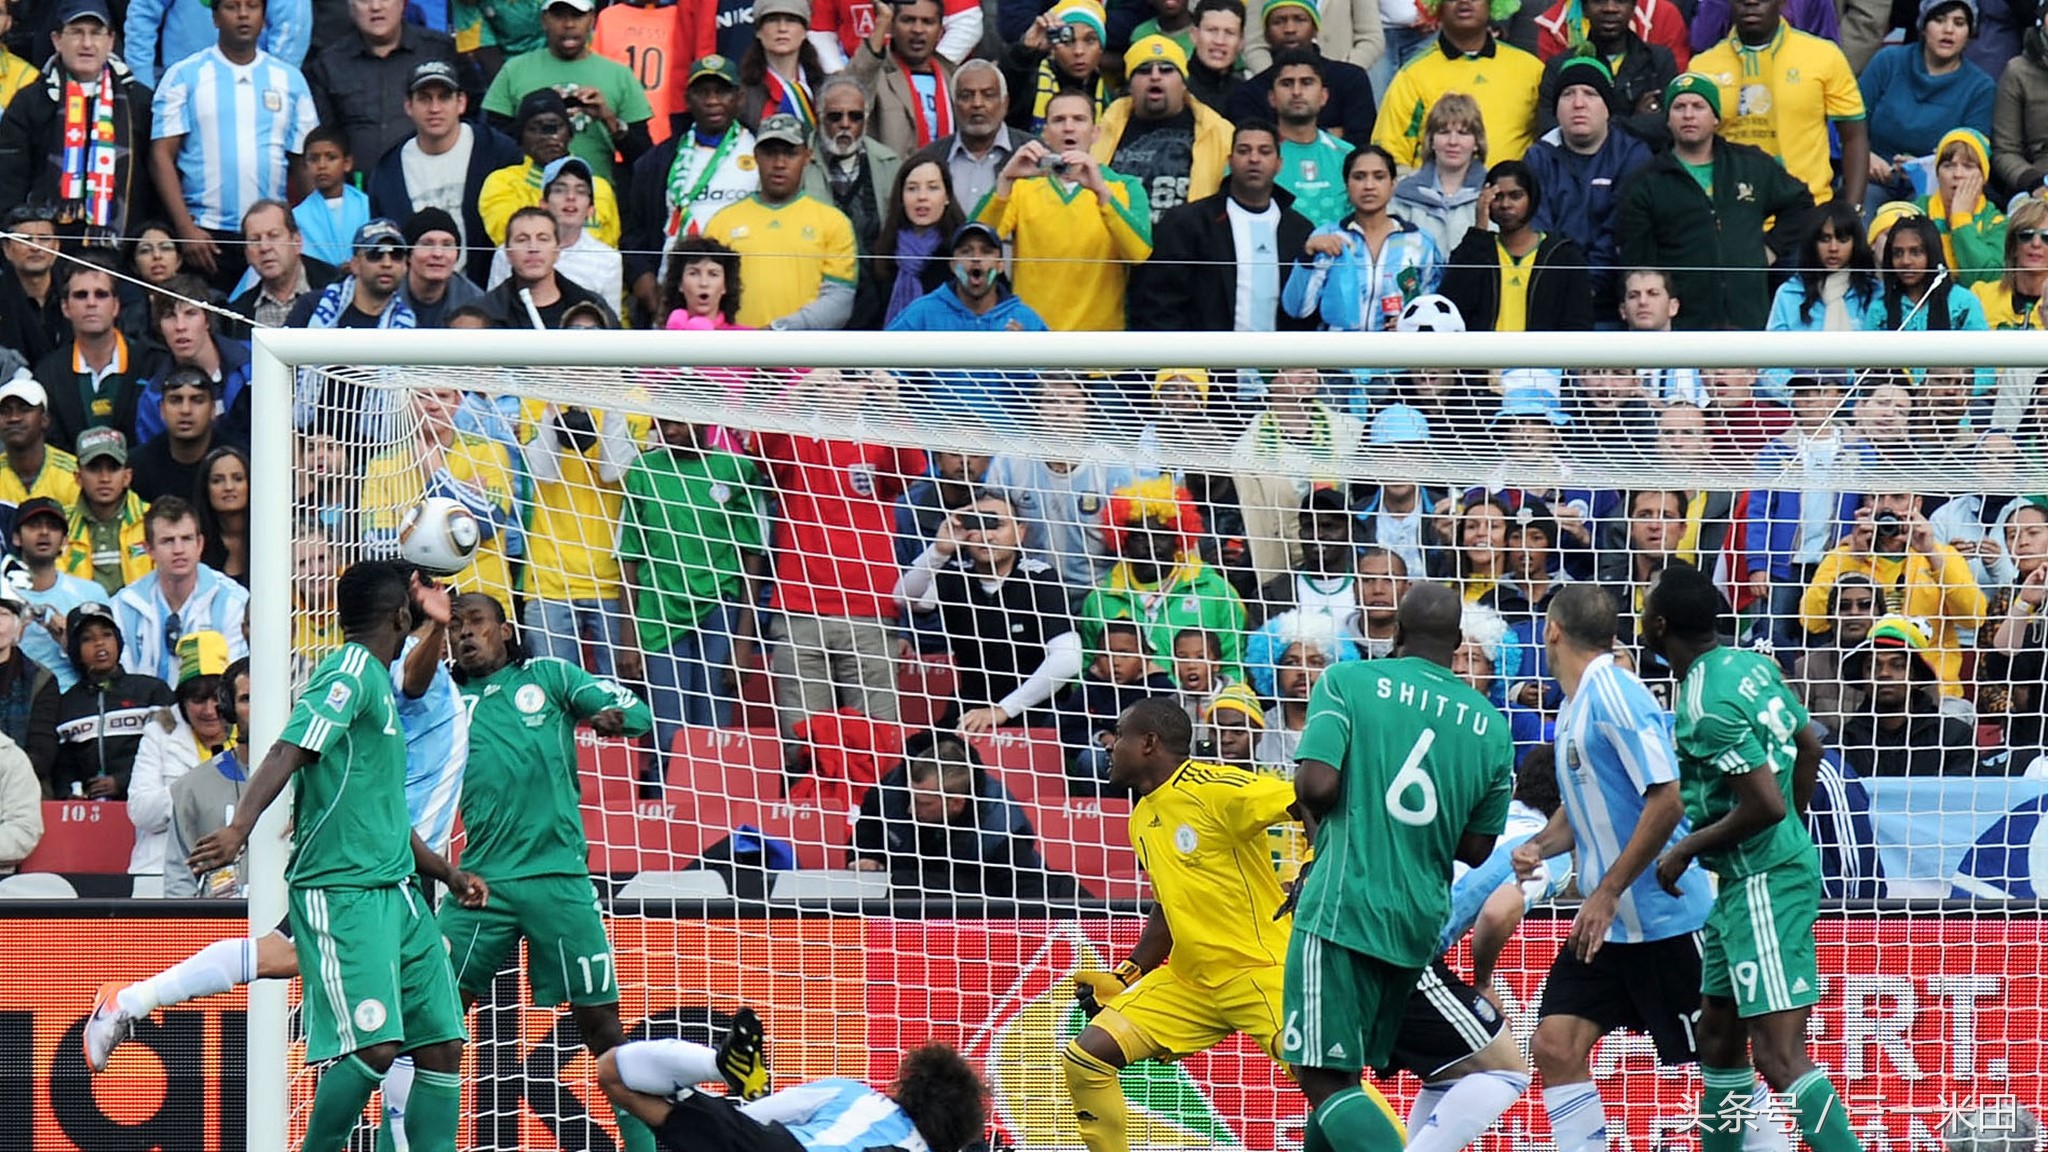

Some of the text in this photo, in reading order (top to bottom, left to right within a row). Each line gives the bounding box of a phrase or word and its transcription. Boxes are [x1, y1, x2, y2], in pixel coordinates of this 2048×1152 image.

[716, 7, 754, 28] NIK
[625, 45, 663, 90] 10
[460, 694, 480, 728] 7
[1376, 677, 1488, 736] SHITTU
[60, 722, 94, 739] BAD
[1386, 727, 1438, 827] 6
[577, 952, 611, 995] 17
[1283, 1009, 1303, 1052] 6
